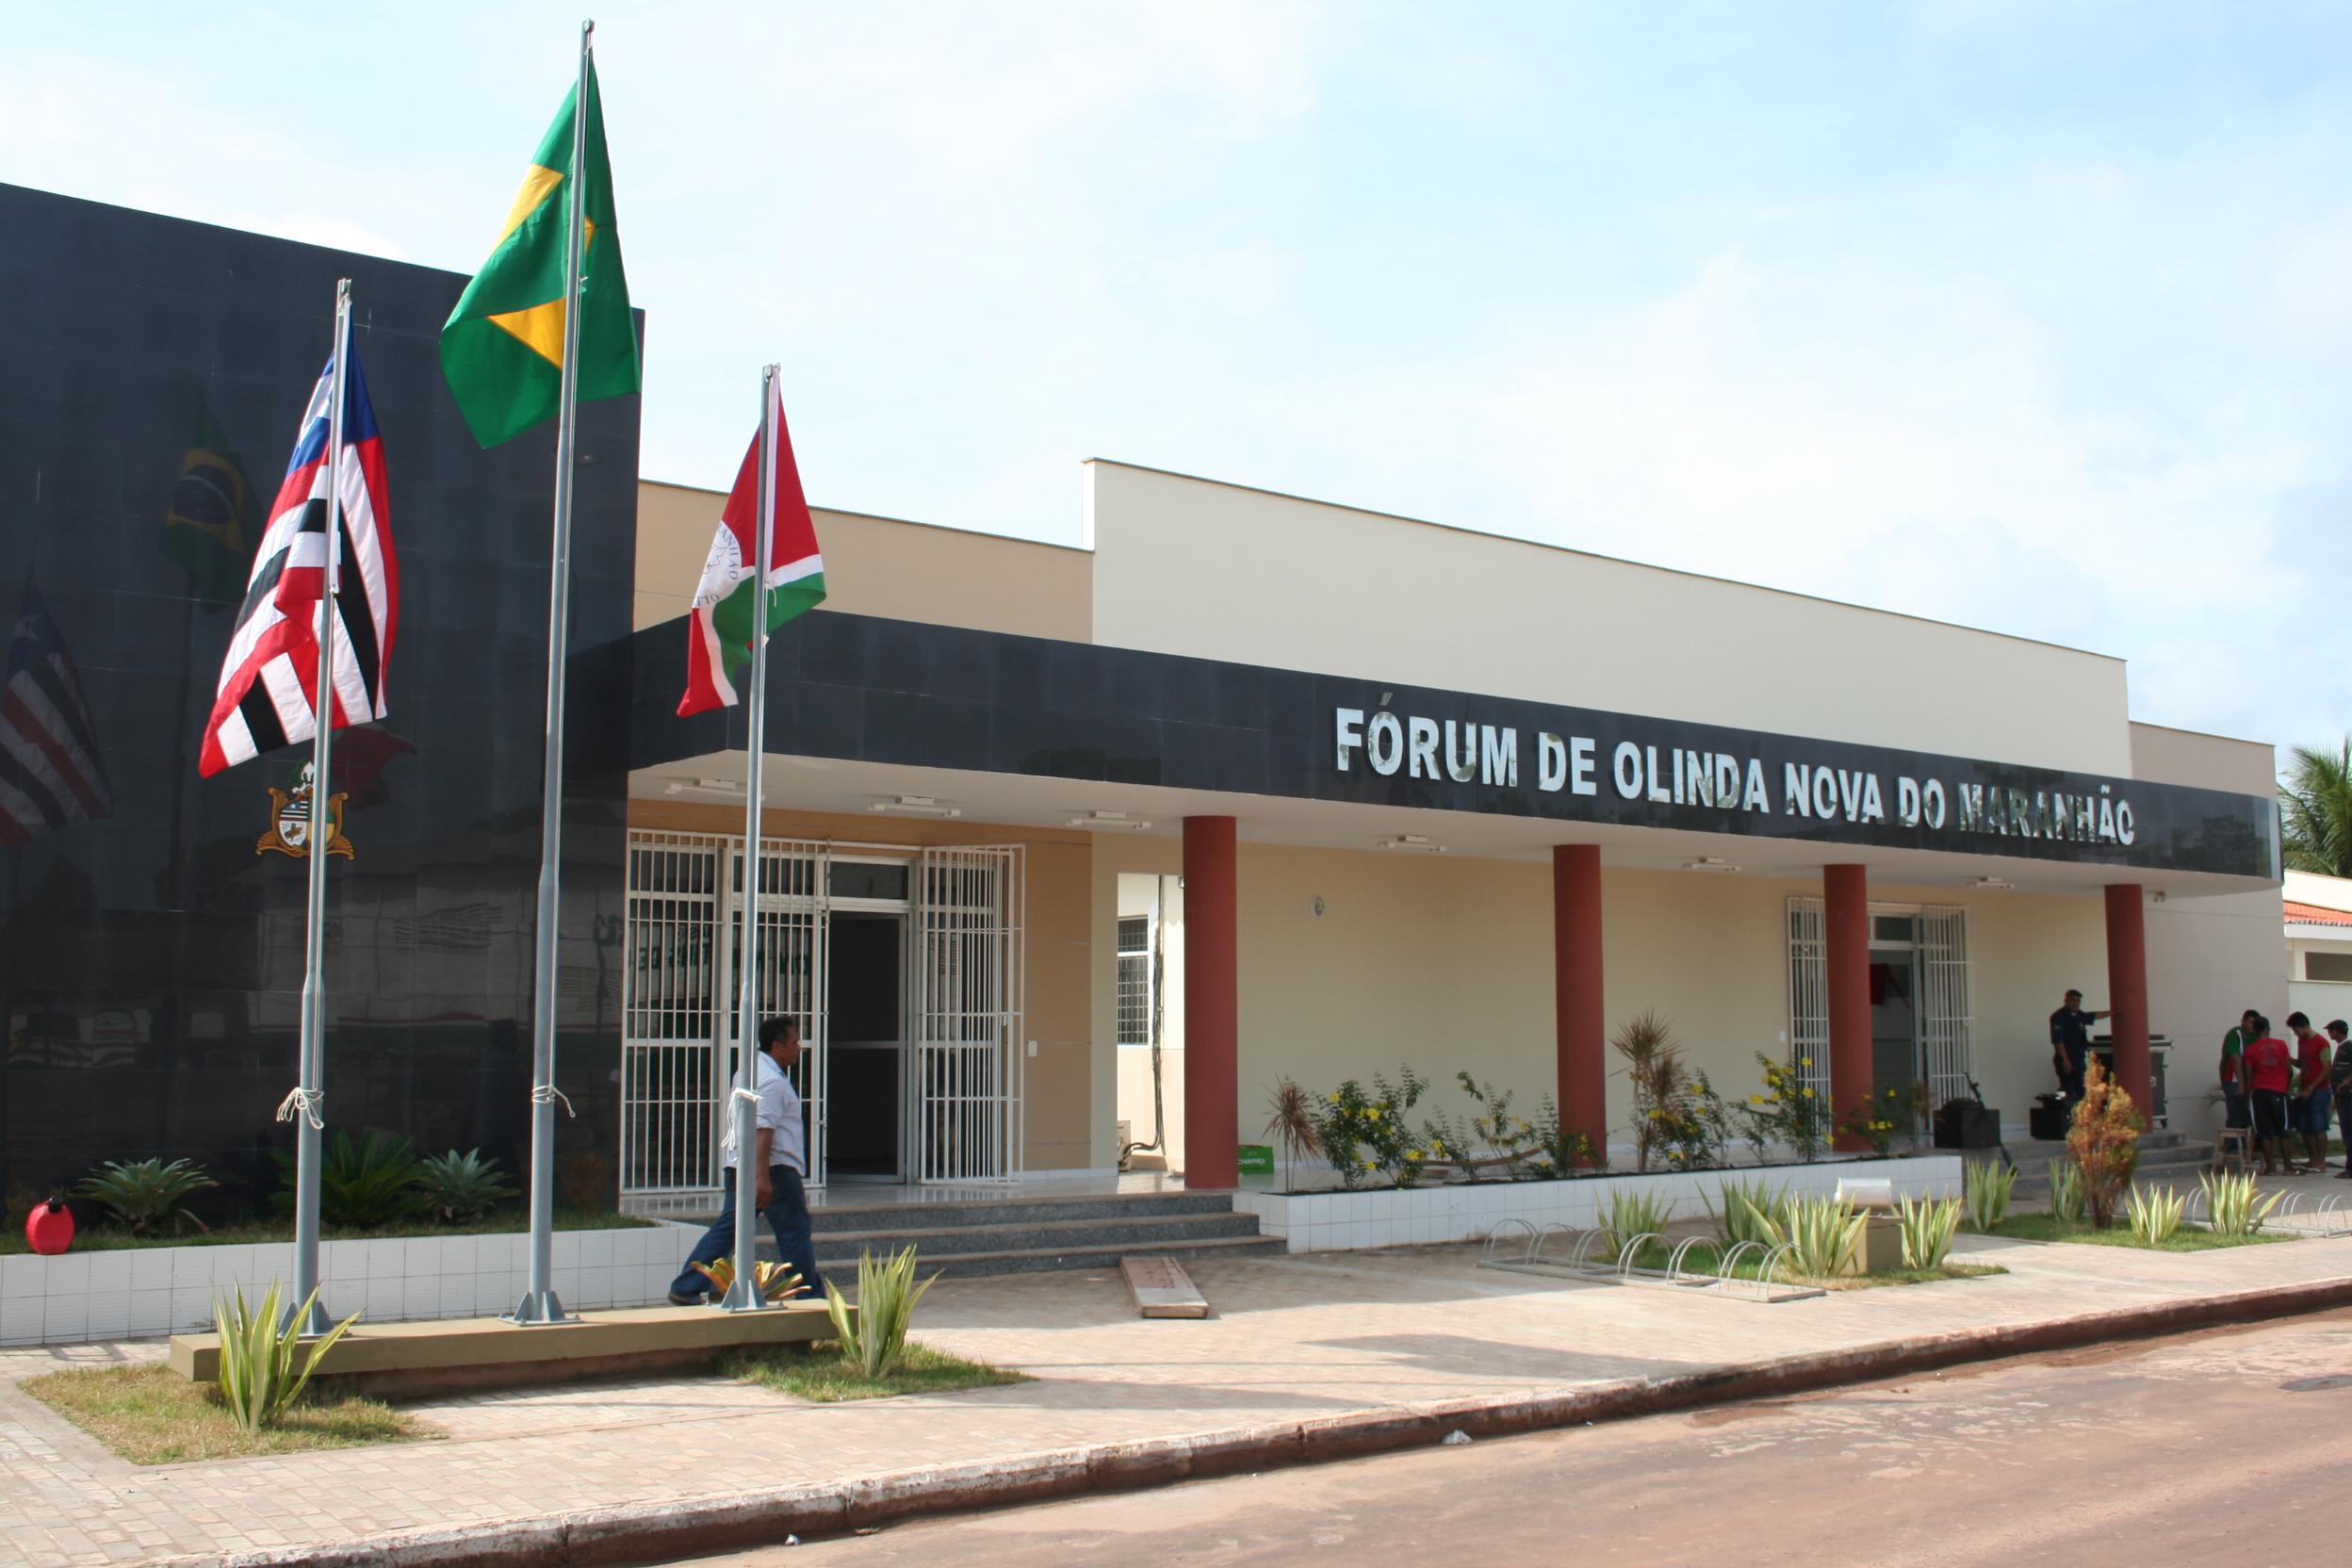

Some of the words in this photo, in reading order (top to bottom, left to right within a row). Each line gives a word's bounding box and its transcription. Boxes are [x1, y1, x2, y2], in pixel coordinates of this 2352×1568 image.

[1336, 692, 1518, 788] FÓRUM
[1538, 731, 1597, 796] DE
[1613, 741, 1771, 814] OLINDA
[1784, 761, 1886, 825] NOVA
[1897, 776, 1947, 830] DO
[1958, 782, 2135, 846] MARANHÃO
